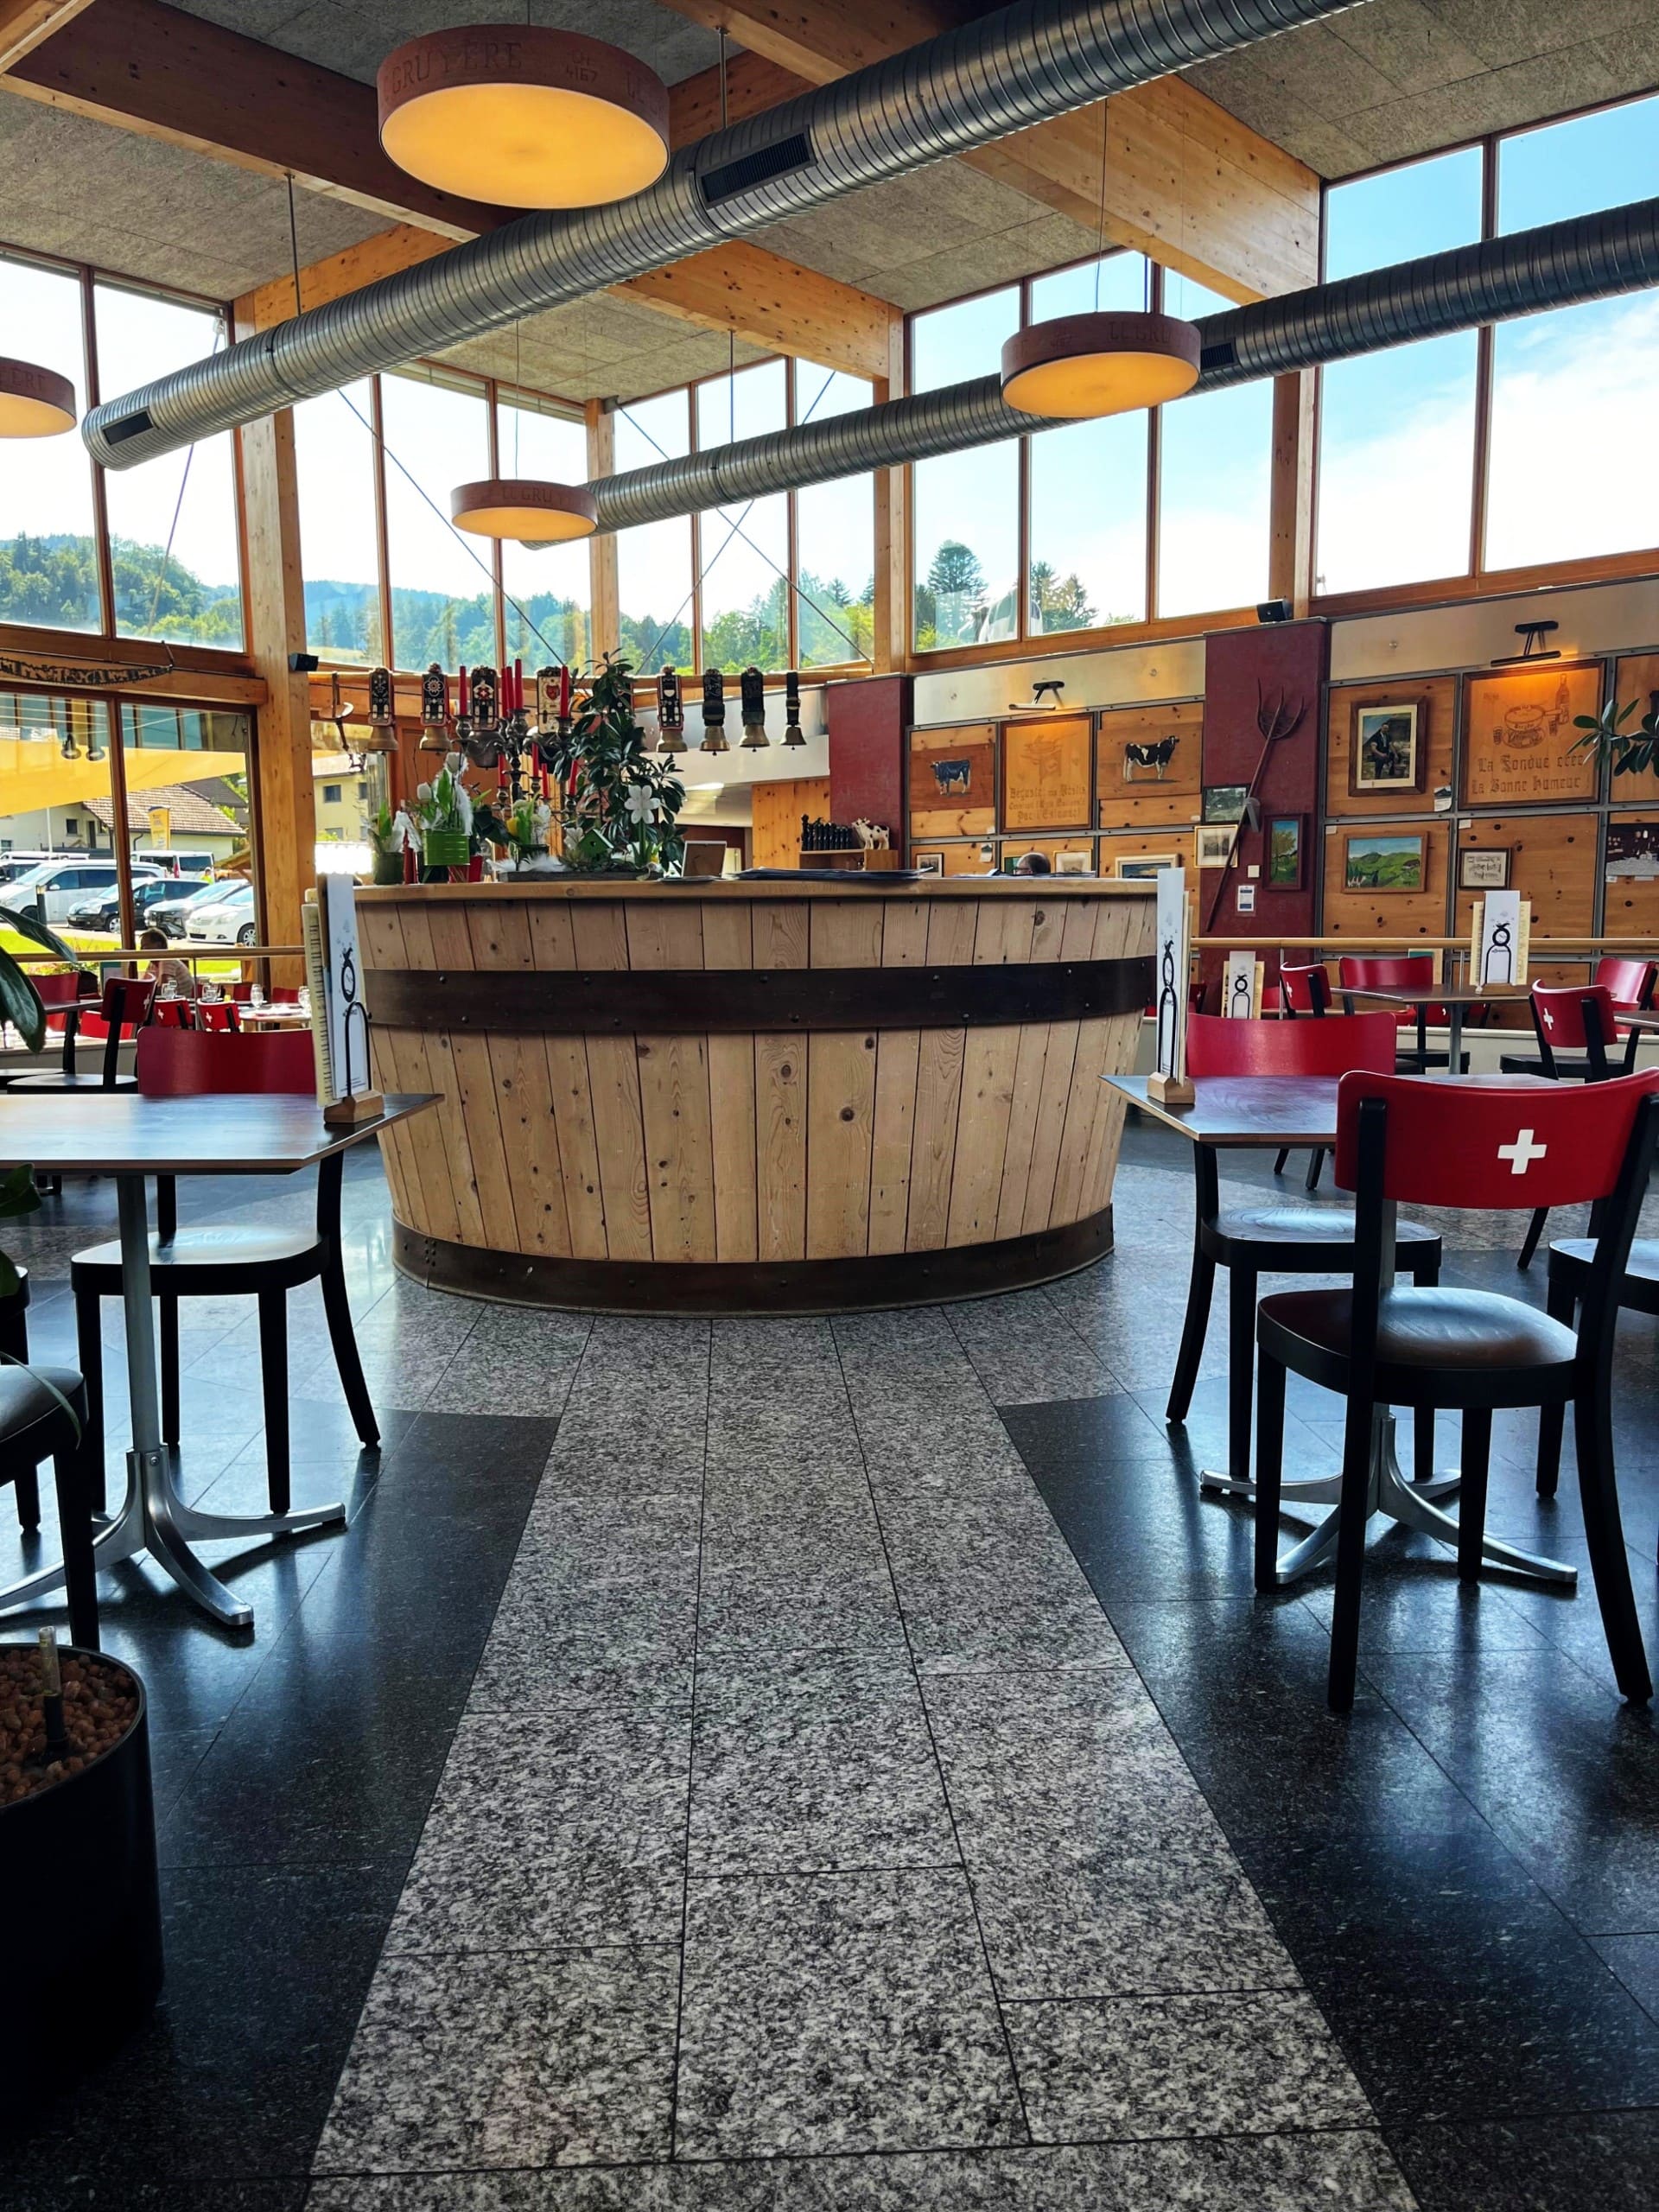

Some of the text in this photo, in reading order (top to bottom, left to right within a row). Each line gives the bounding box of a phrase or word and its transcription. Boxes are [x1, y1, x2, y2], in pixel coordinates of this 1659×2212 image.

[1478, 758, 1494, 772] La
[1499, 754, 1549, 773] Fondue
[1490, 778, 1529, 794] Bonne
